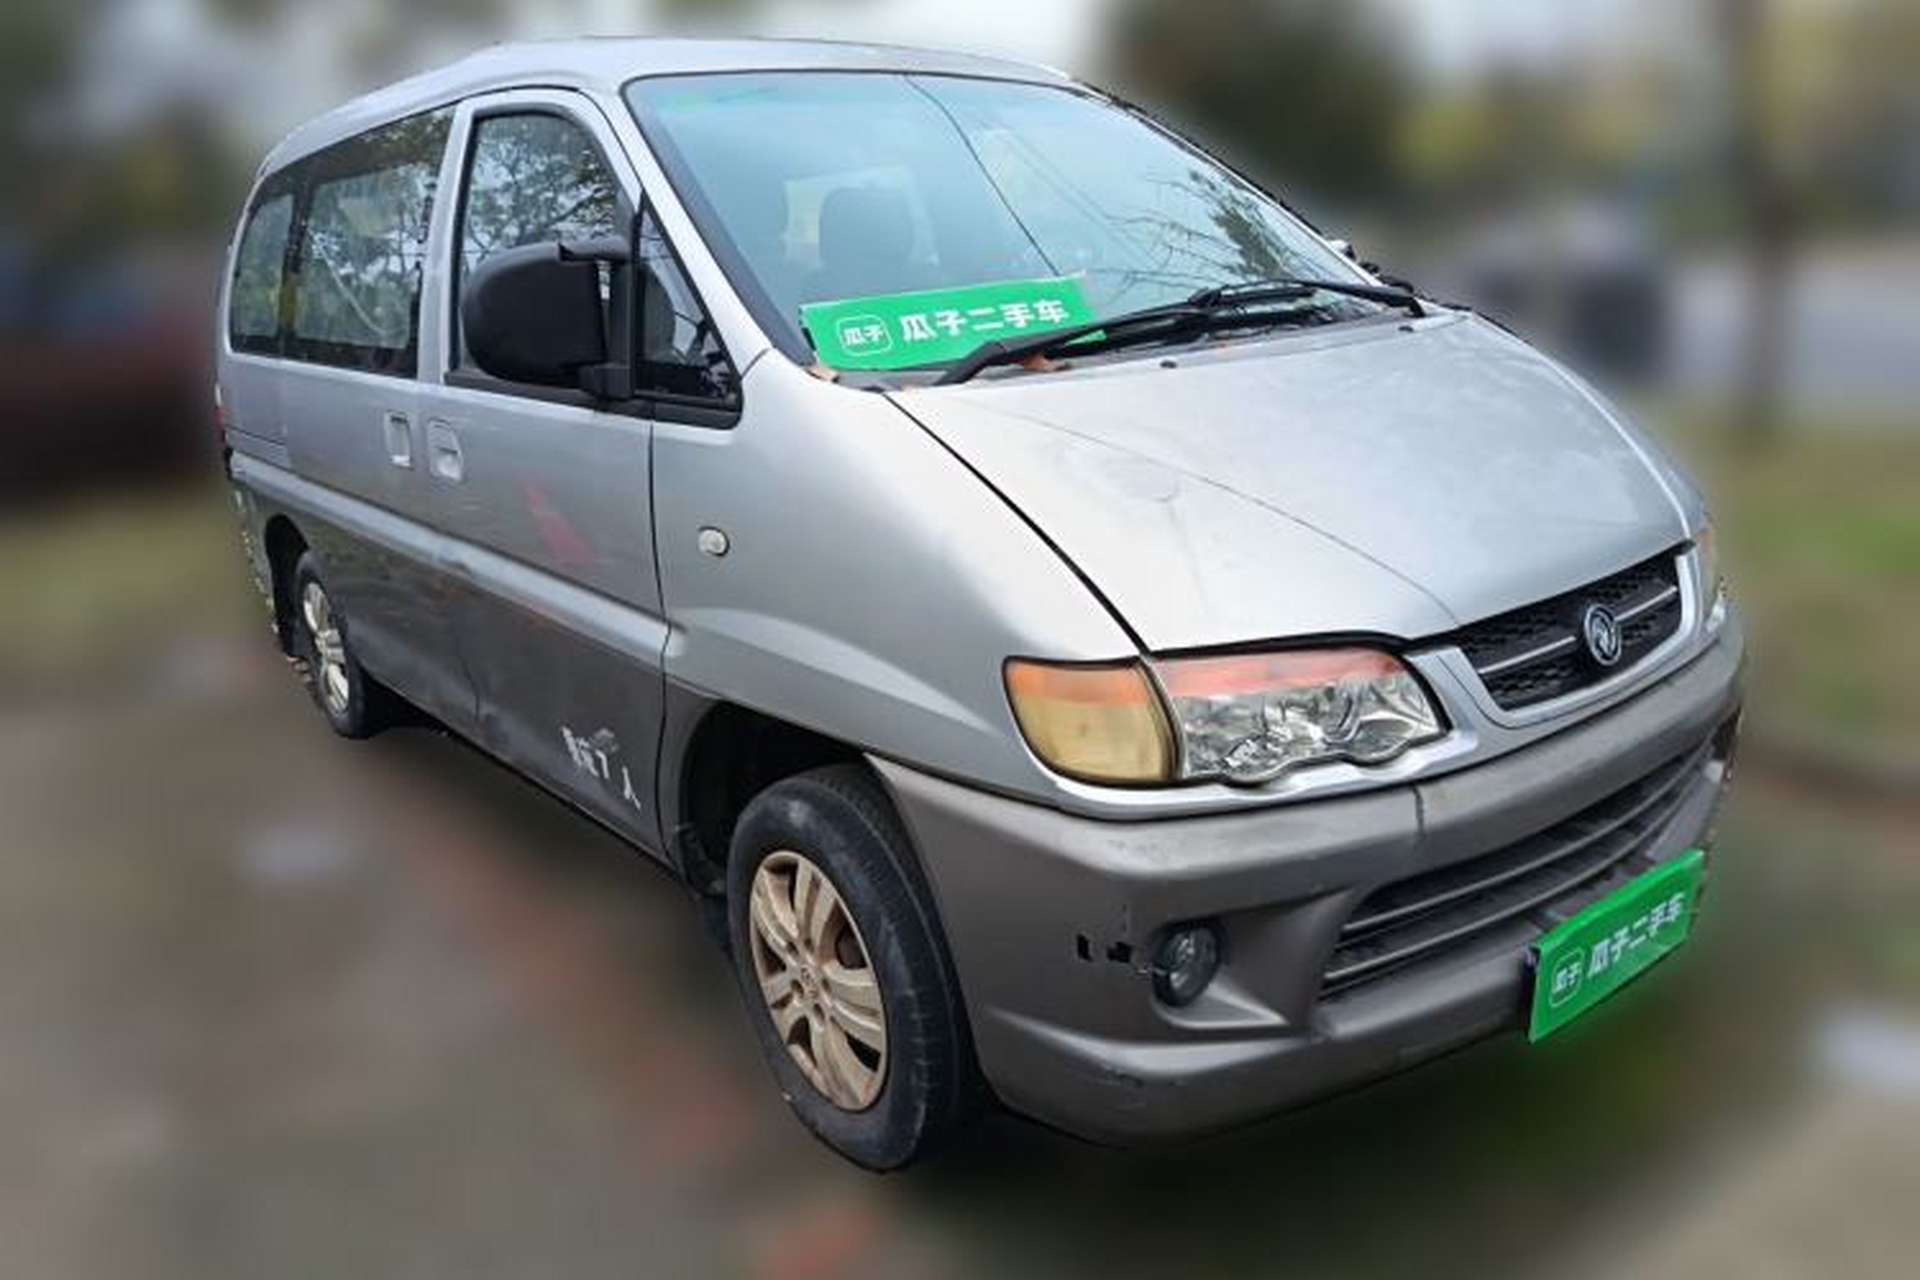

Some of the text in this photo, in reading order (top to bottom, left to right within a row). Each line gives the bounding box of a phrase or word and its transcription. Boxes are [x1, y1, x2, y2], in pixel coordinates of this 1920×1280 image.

[842, 326, 885, 346] 瓜子
[899, 299, 1070, 342] 瓜子二手车
[1587, 891, 1686, 978] 瓜子二手车
